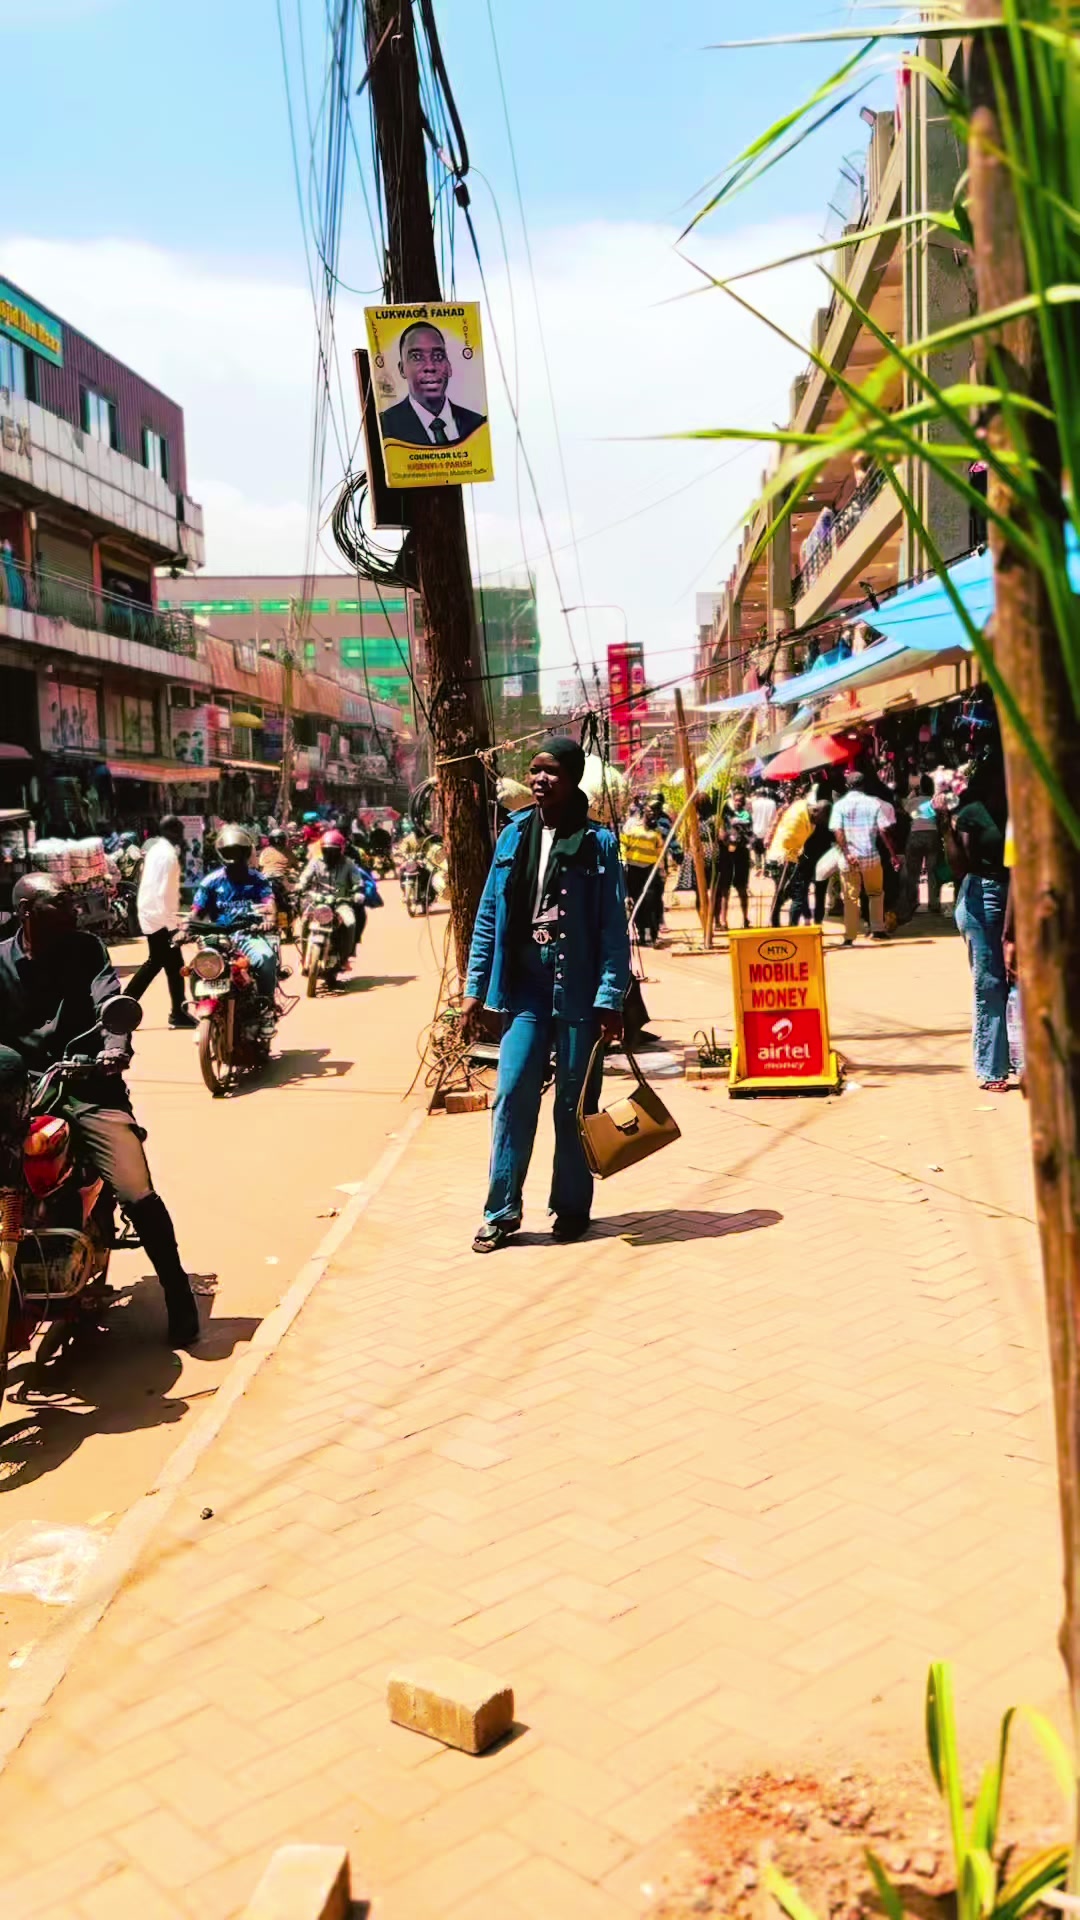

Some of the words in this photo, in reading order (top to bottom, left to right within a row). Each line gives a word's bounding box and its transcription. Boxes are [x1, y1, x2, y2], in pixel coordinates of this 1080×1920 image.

[375, 308, 428, 320] LUKWAGO
[431, 308, 465, 318] FAHAD
[409, 451, 451, 461] COUNCILOR
[445, 460, 473, 470] PARISH
[767, 945, 788, 954] MTN
[749, 962, 809, 983] MOBILE
[751, 987, 808, 1008] MONEY
[757, 1043, 811, 1060] airtel
[763, 1061, 805, 1070] money
